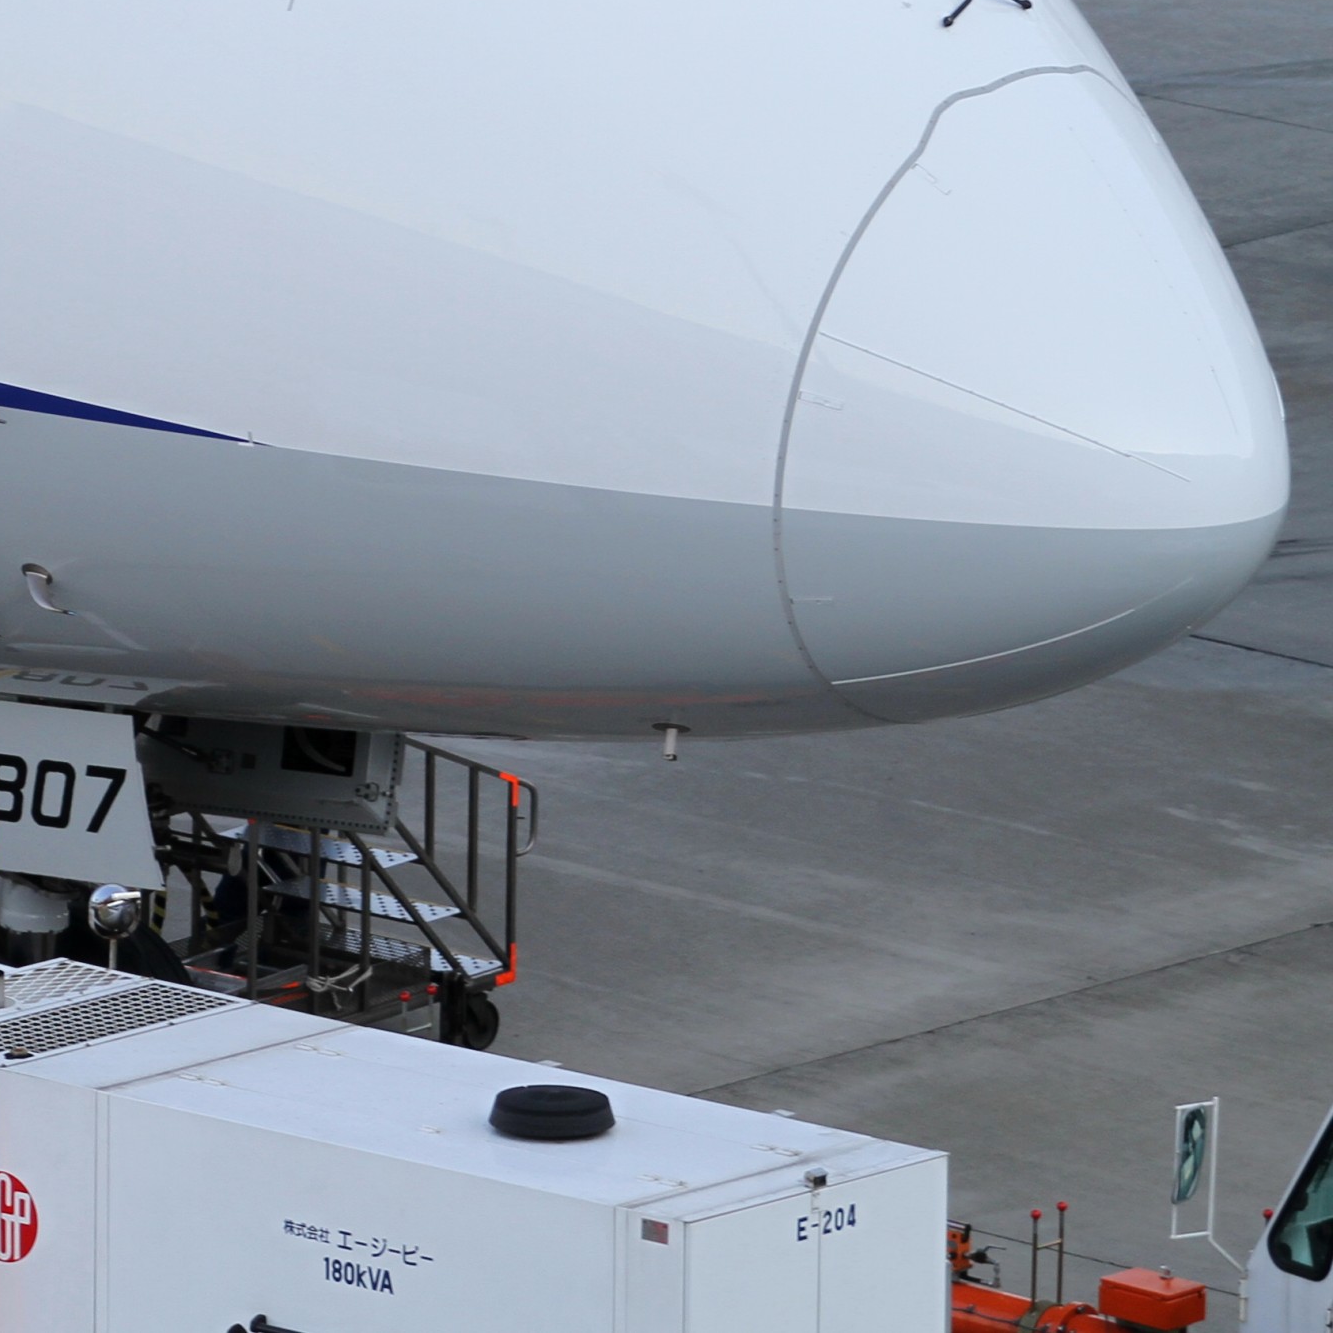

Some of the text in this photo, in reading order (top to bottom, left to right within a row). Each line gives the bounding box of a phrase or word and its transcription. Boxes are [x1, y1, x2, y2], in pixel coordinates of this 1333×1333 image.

[283, 1219, 331, 1245] 株式会社
[796, 1204, 857, 1242] E-204
[323, 1256, 395, 1296] 180kVA
